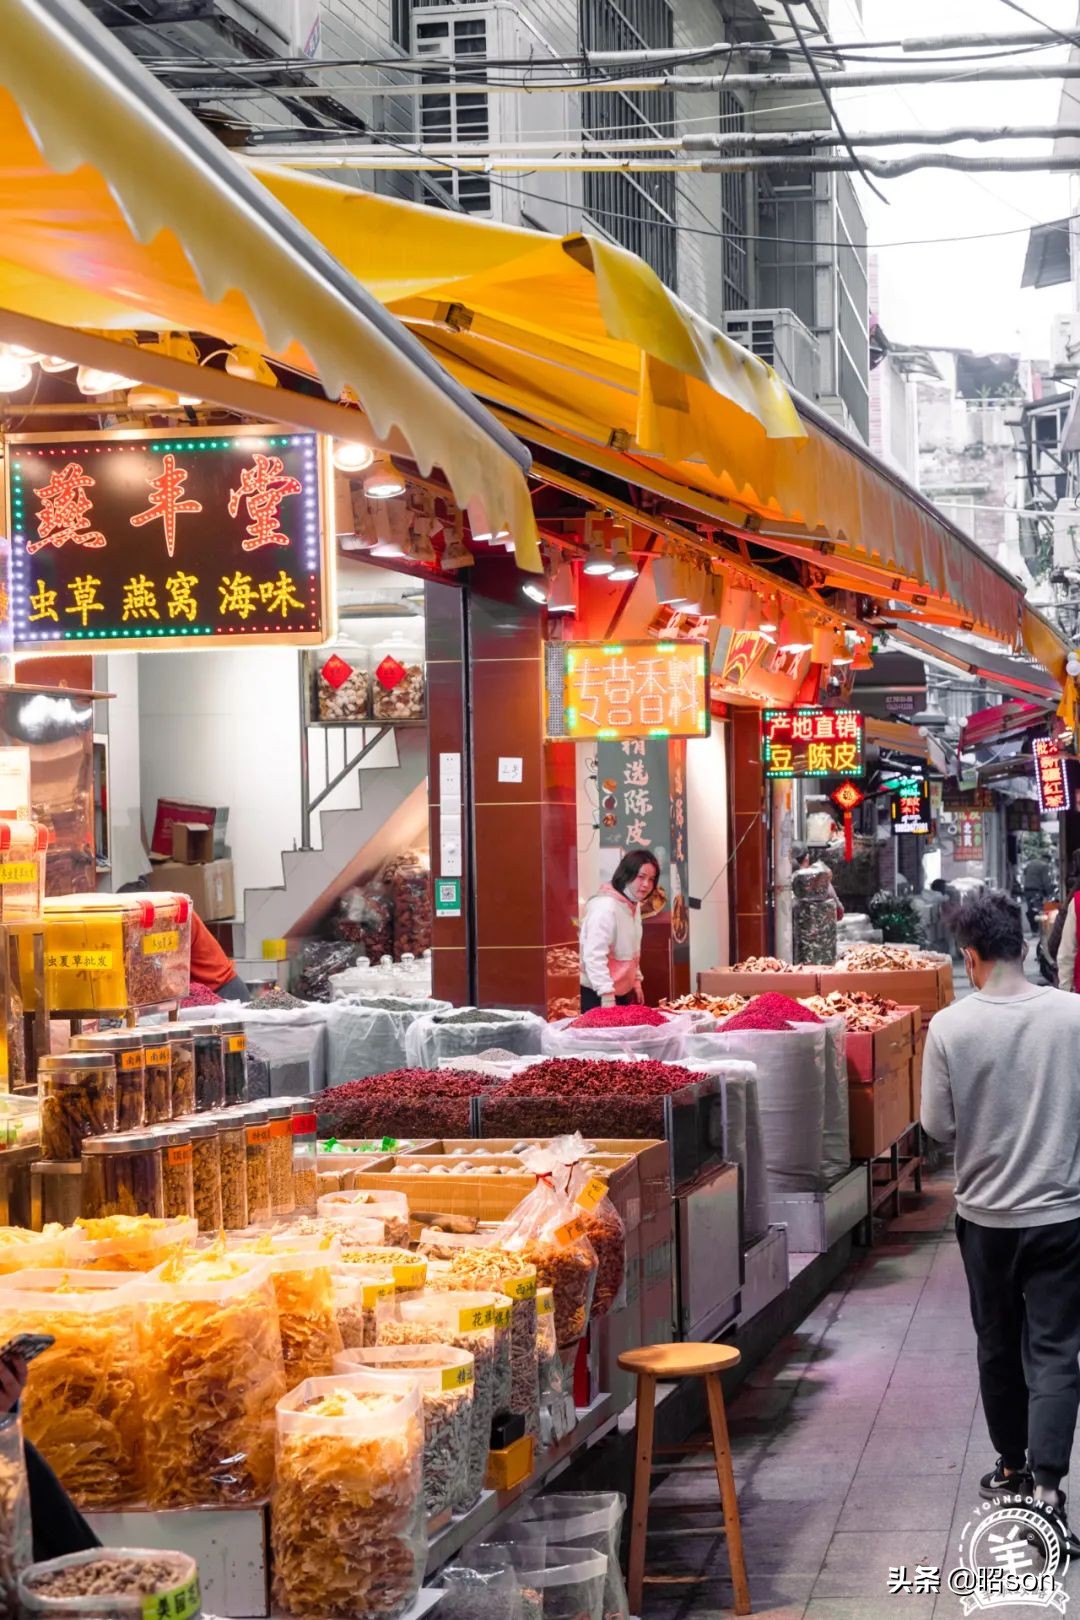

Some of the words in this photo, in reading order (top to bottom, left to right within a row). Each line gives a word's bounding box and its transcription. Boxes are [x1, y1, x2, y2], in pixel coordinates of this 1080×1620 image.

[26, 453, 302, 557] 燕丰堂
[28, 574, 105, 626] 虫草
[121, 570, 199, 622] 燕窝
[217, 570, 305, 619] 海味
[769, 714, 858, 740] 产地直销
[807, 741, 857, 771] 陈皮
